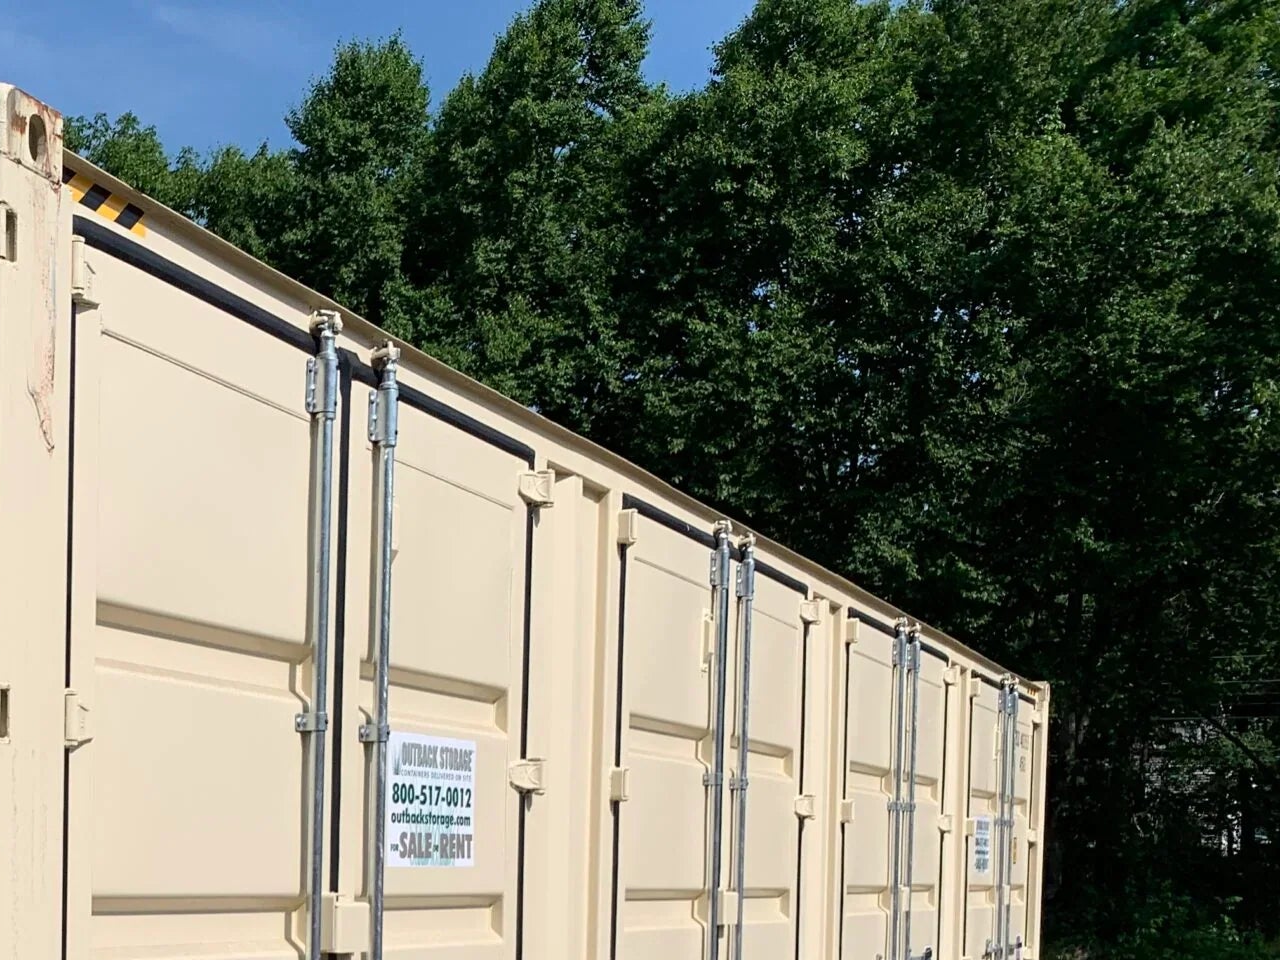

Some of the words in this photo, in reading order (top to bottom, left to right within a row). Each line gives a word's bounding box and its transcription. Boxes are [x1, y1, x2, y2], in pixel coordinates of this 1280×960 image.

[402, 742, 438, 768] OUTBACK
[439, 746, 472, 772] STORAGE
[392, 783, 471, 808] 800-517-0012
[391, 808, 471, 829] outbackstorage.com
[399, 832, 432, 859] SALE
[440, 833, 472, 859] RENT
